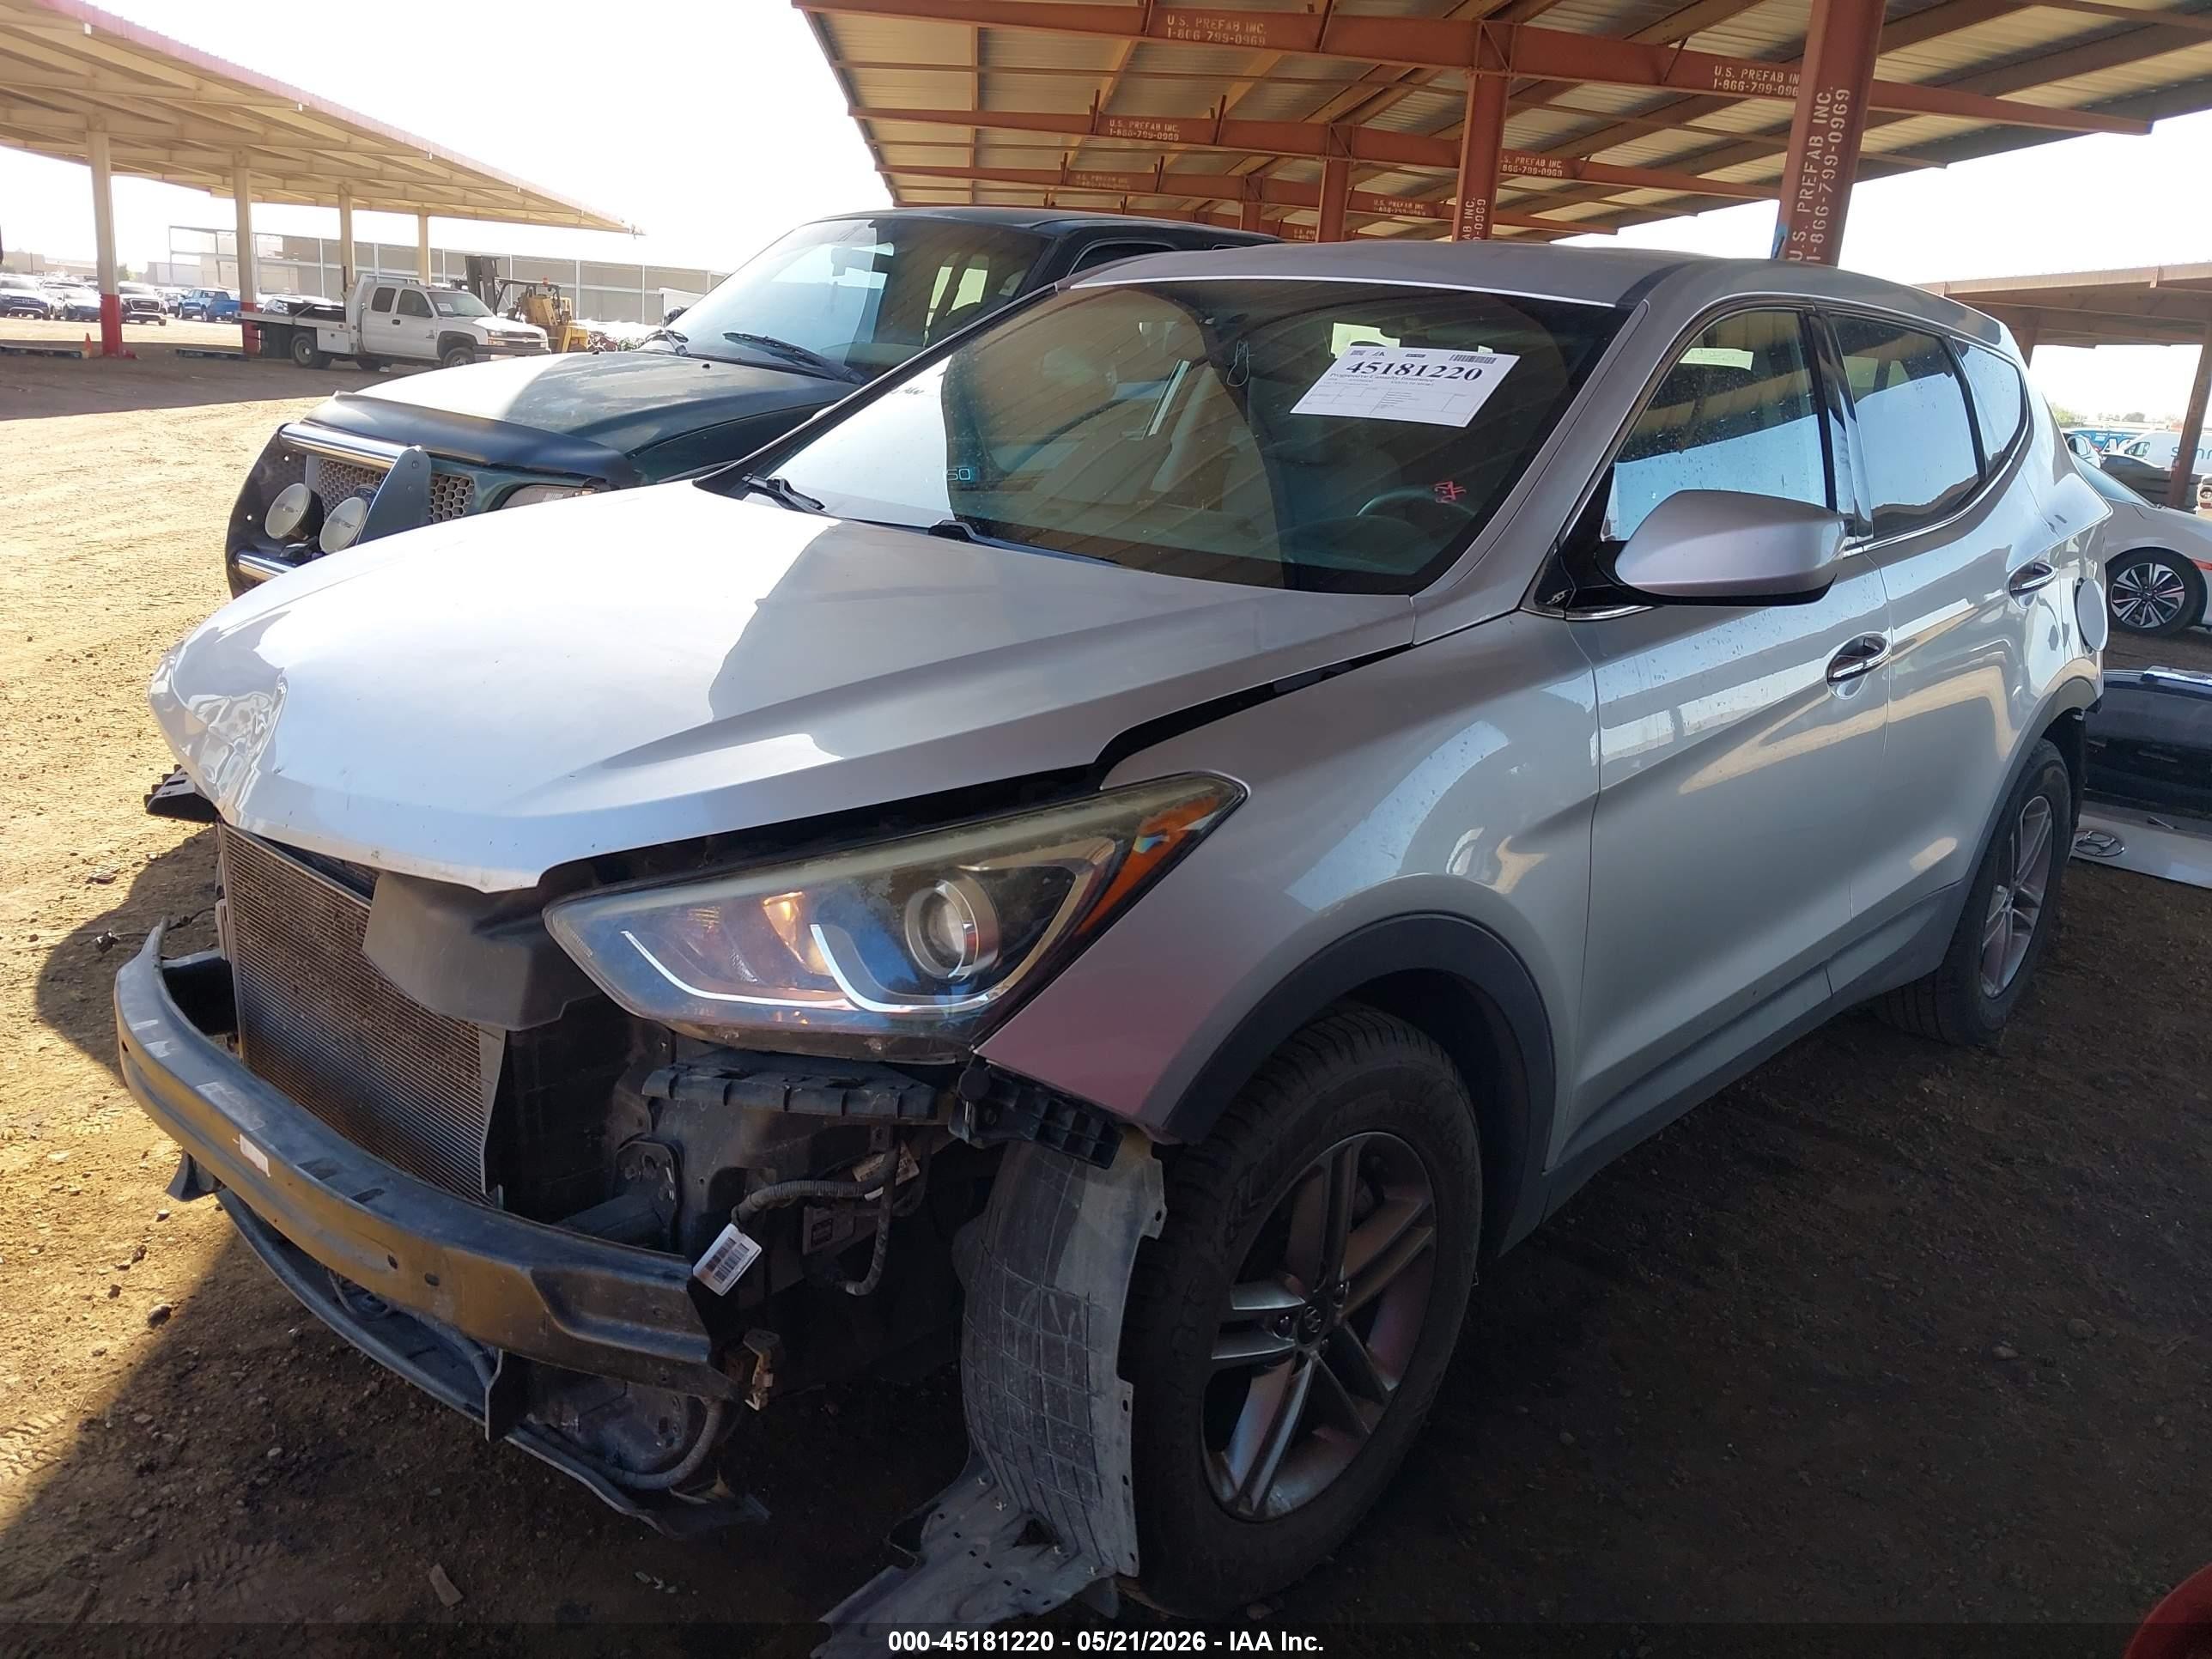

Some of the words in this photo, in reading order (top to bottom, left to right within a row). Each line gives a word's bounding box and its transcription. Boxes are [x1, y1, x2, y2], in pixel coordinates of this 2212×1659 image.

[1195, 17, 1240, 32] PREFAB
[1714, 65, 1735, 78] U.S.
[1741, 68, 1784, 83] PREFAB
[1789, 73, 1801, 85] IN
[1713, 78, 1800, 97] 1-866-799-096
[1813, 86, 1834, 125] INC.
[1515, 156, 1546, 167] PREFAB
[1797, 135, 1824, 213] PREFAB
[1807, 88, 1850, 261] 1-866-799-0969
[1790, 225, 1808, 261] U.S.
[1346, 361, 1483, 381] 45181220
